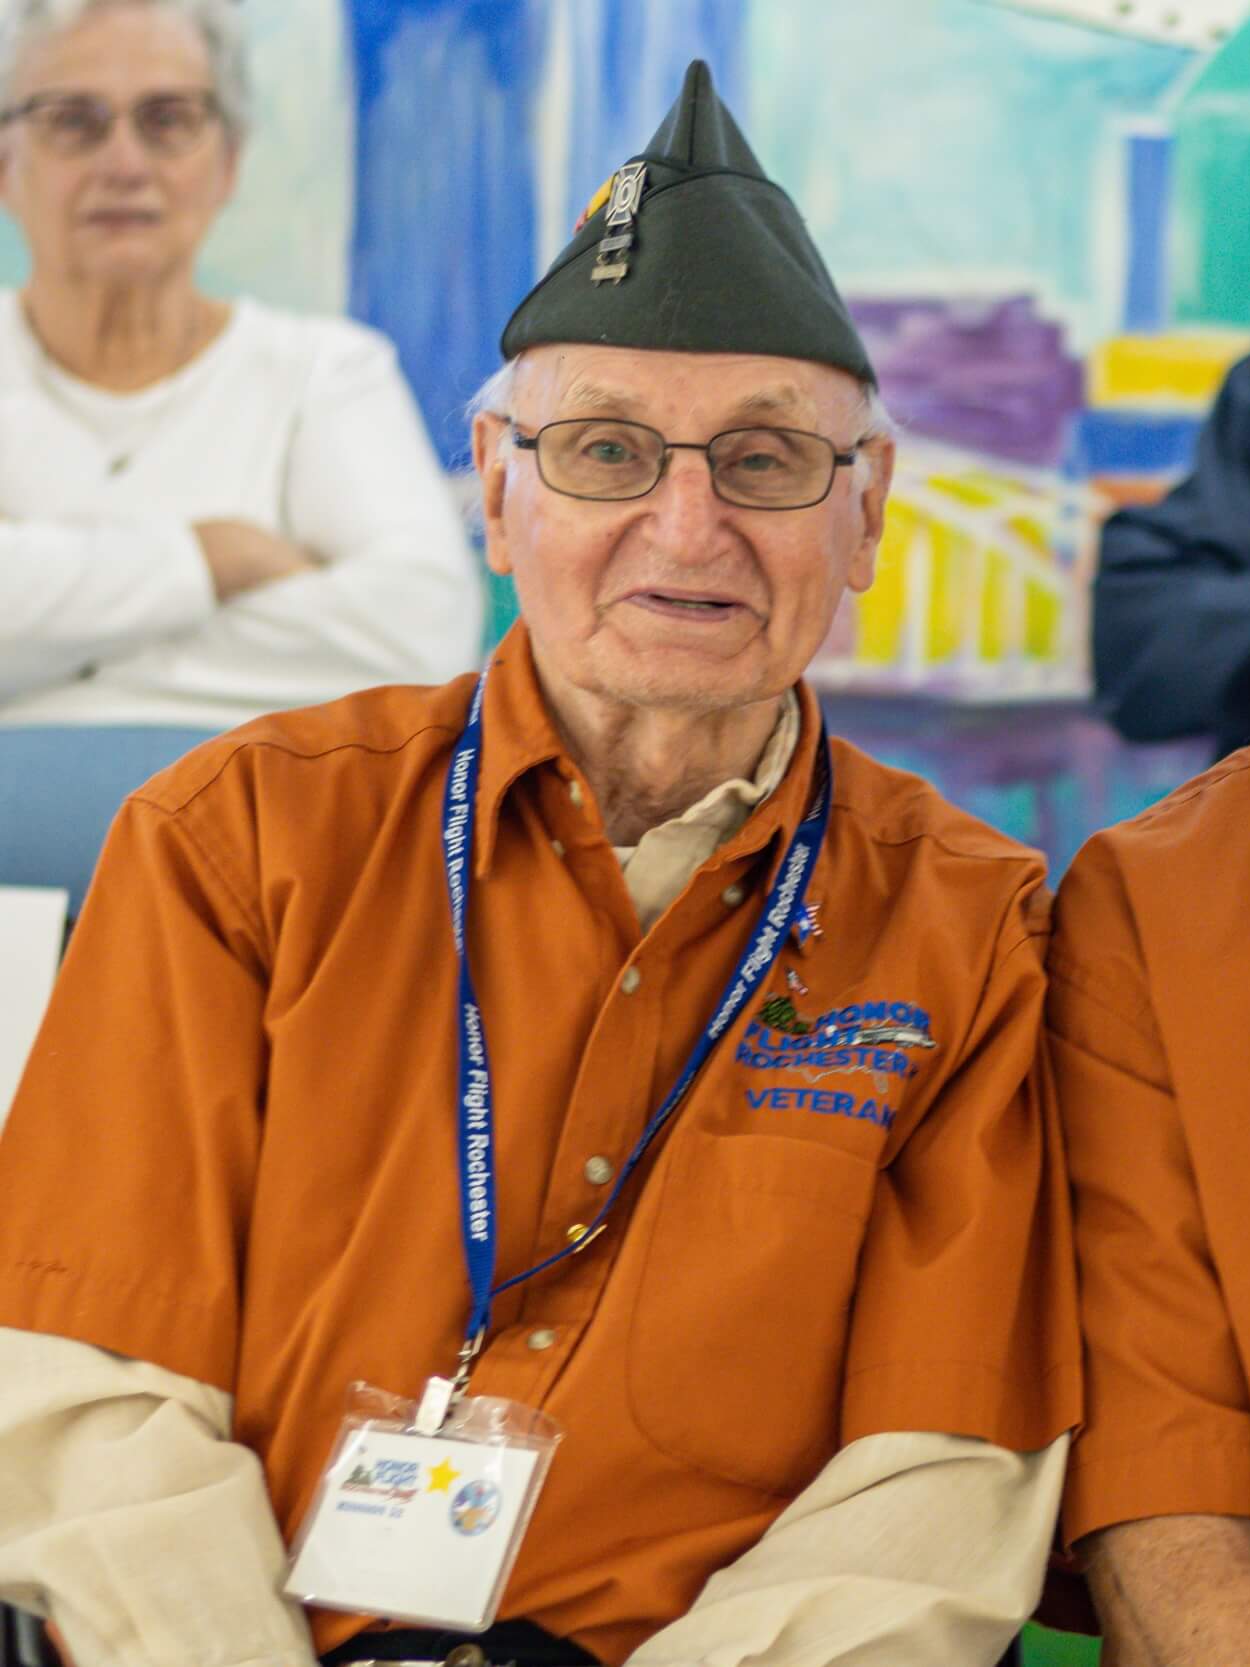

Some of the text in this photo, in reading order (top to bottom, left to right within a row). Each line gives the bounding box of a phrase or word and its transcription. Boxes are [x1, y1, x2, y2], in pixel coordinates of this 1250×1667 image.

[451, 748, 475, 802] Honor
[444, 803, 470, 858] Flight
[707, 842, 811, 1040] Honor Flight Rochester
[743, 1017, 862, 1052] FLIGHT
[815, 1000, 931, 1031] HONOR
[735, 1041, 910, 1077] ROCHESTER
[463, 1003, 492, 1243] Honor Flight Rochester
[746, 1087, 897, 1130] VETERAN
